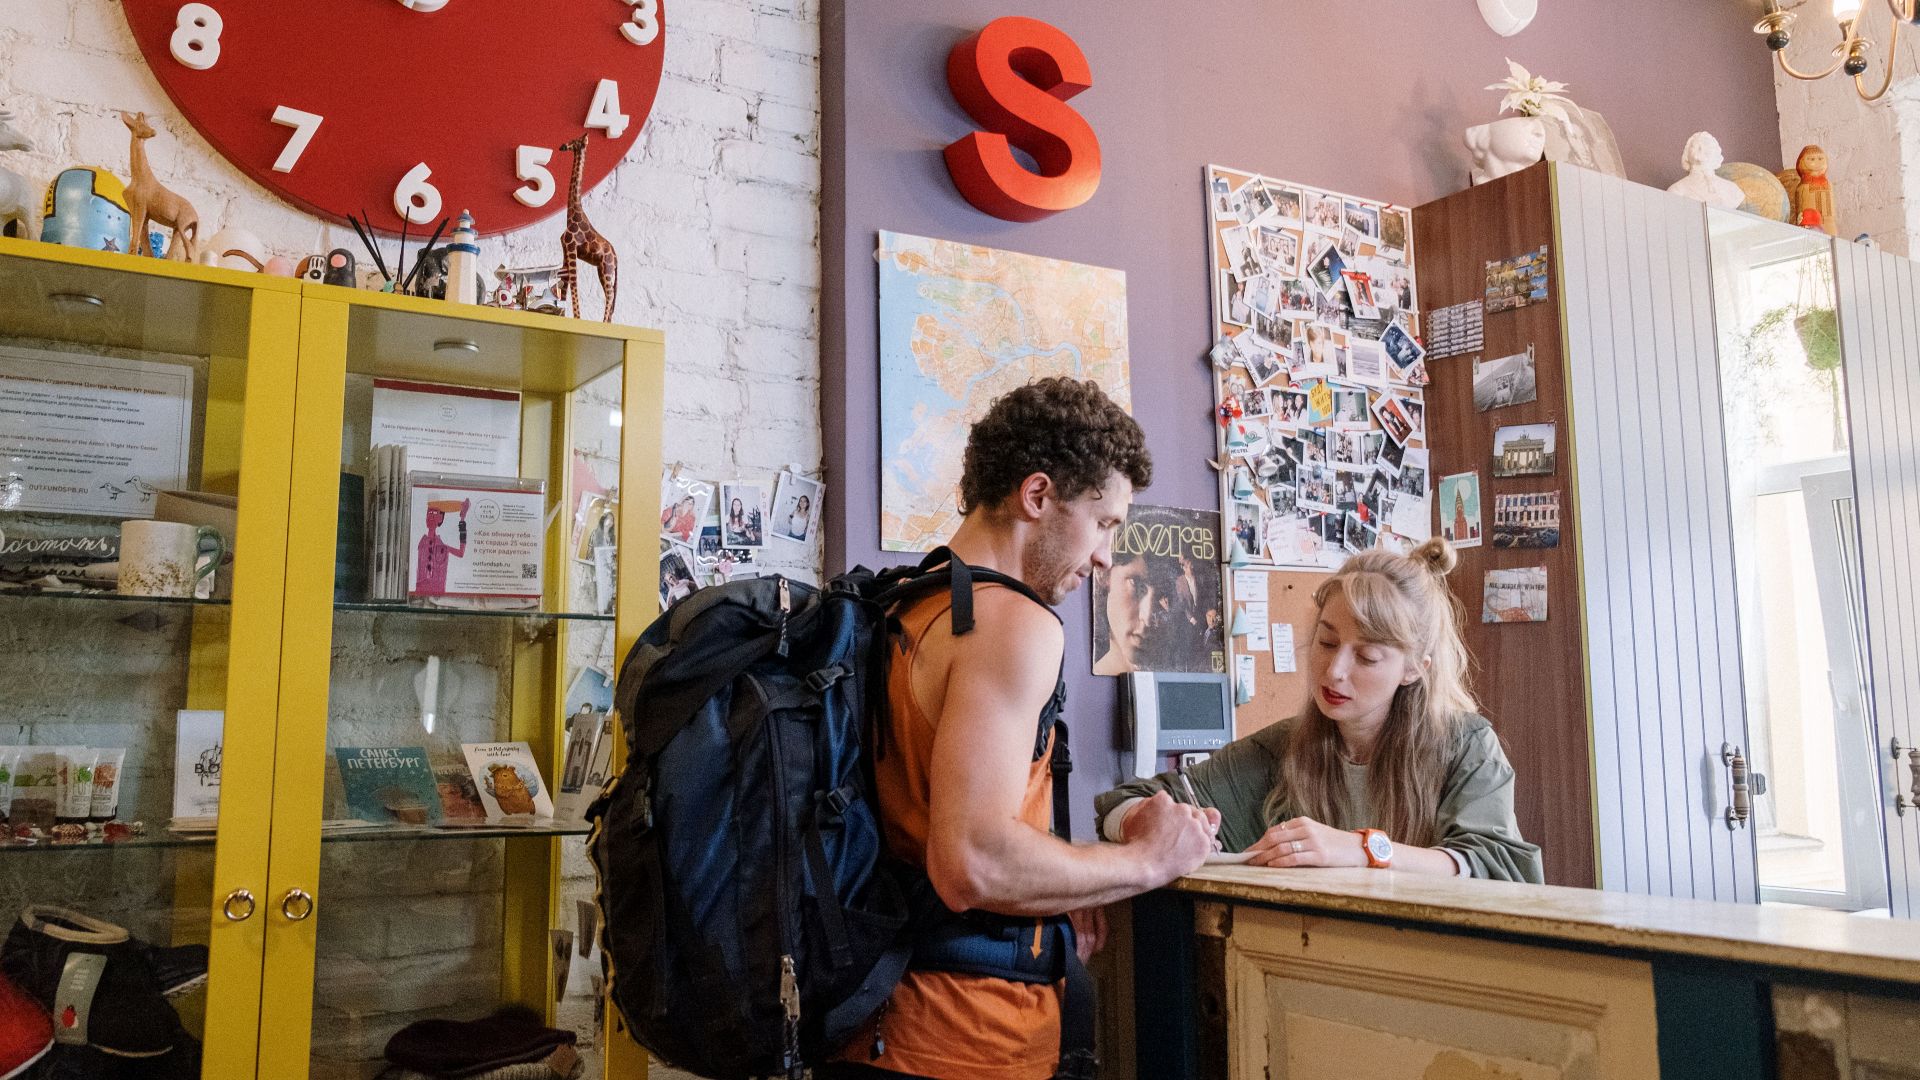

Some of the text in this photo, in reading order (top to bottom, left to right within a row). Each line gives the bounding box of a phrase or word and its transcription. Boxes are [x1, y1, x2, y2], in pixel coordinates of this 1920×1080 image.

[169, 2, 223, 71] 8
[617, 0, 660, 46] 3
[270, 105, 324, 174] 7
[582, 78, 631, 139] 4
[944, 16, 1102, 223] S
[393, 161, 442, 226] 6
[512, 144, 556, 209] 5
[348, 757, 420, 769] ПЕТЕРБУРГ
[359, 748, 403, 758] САНКТ-
